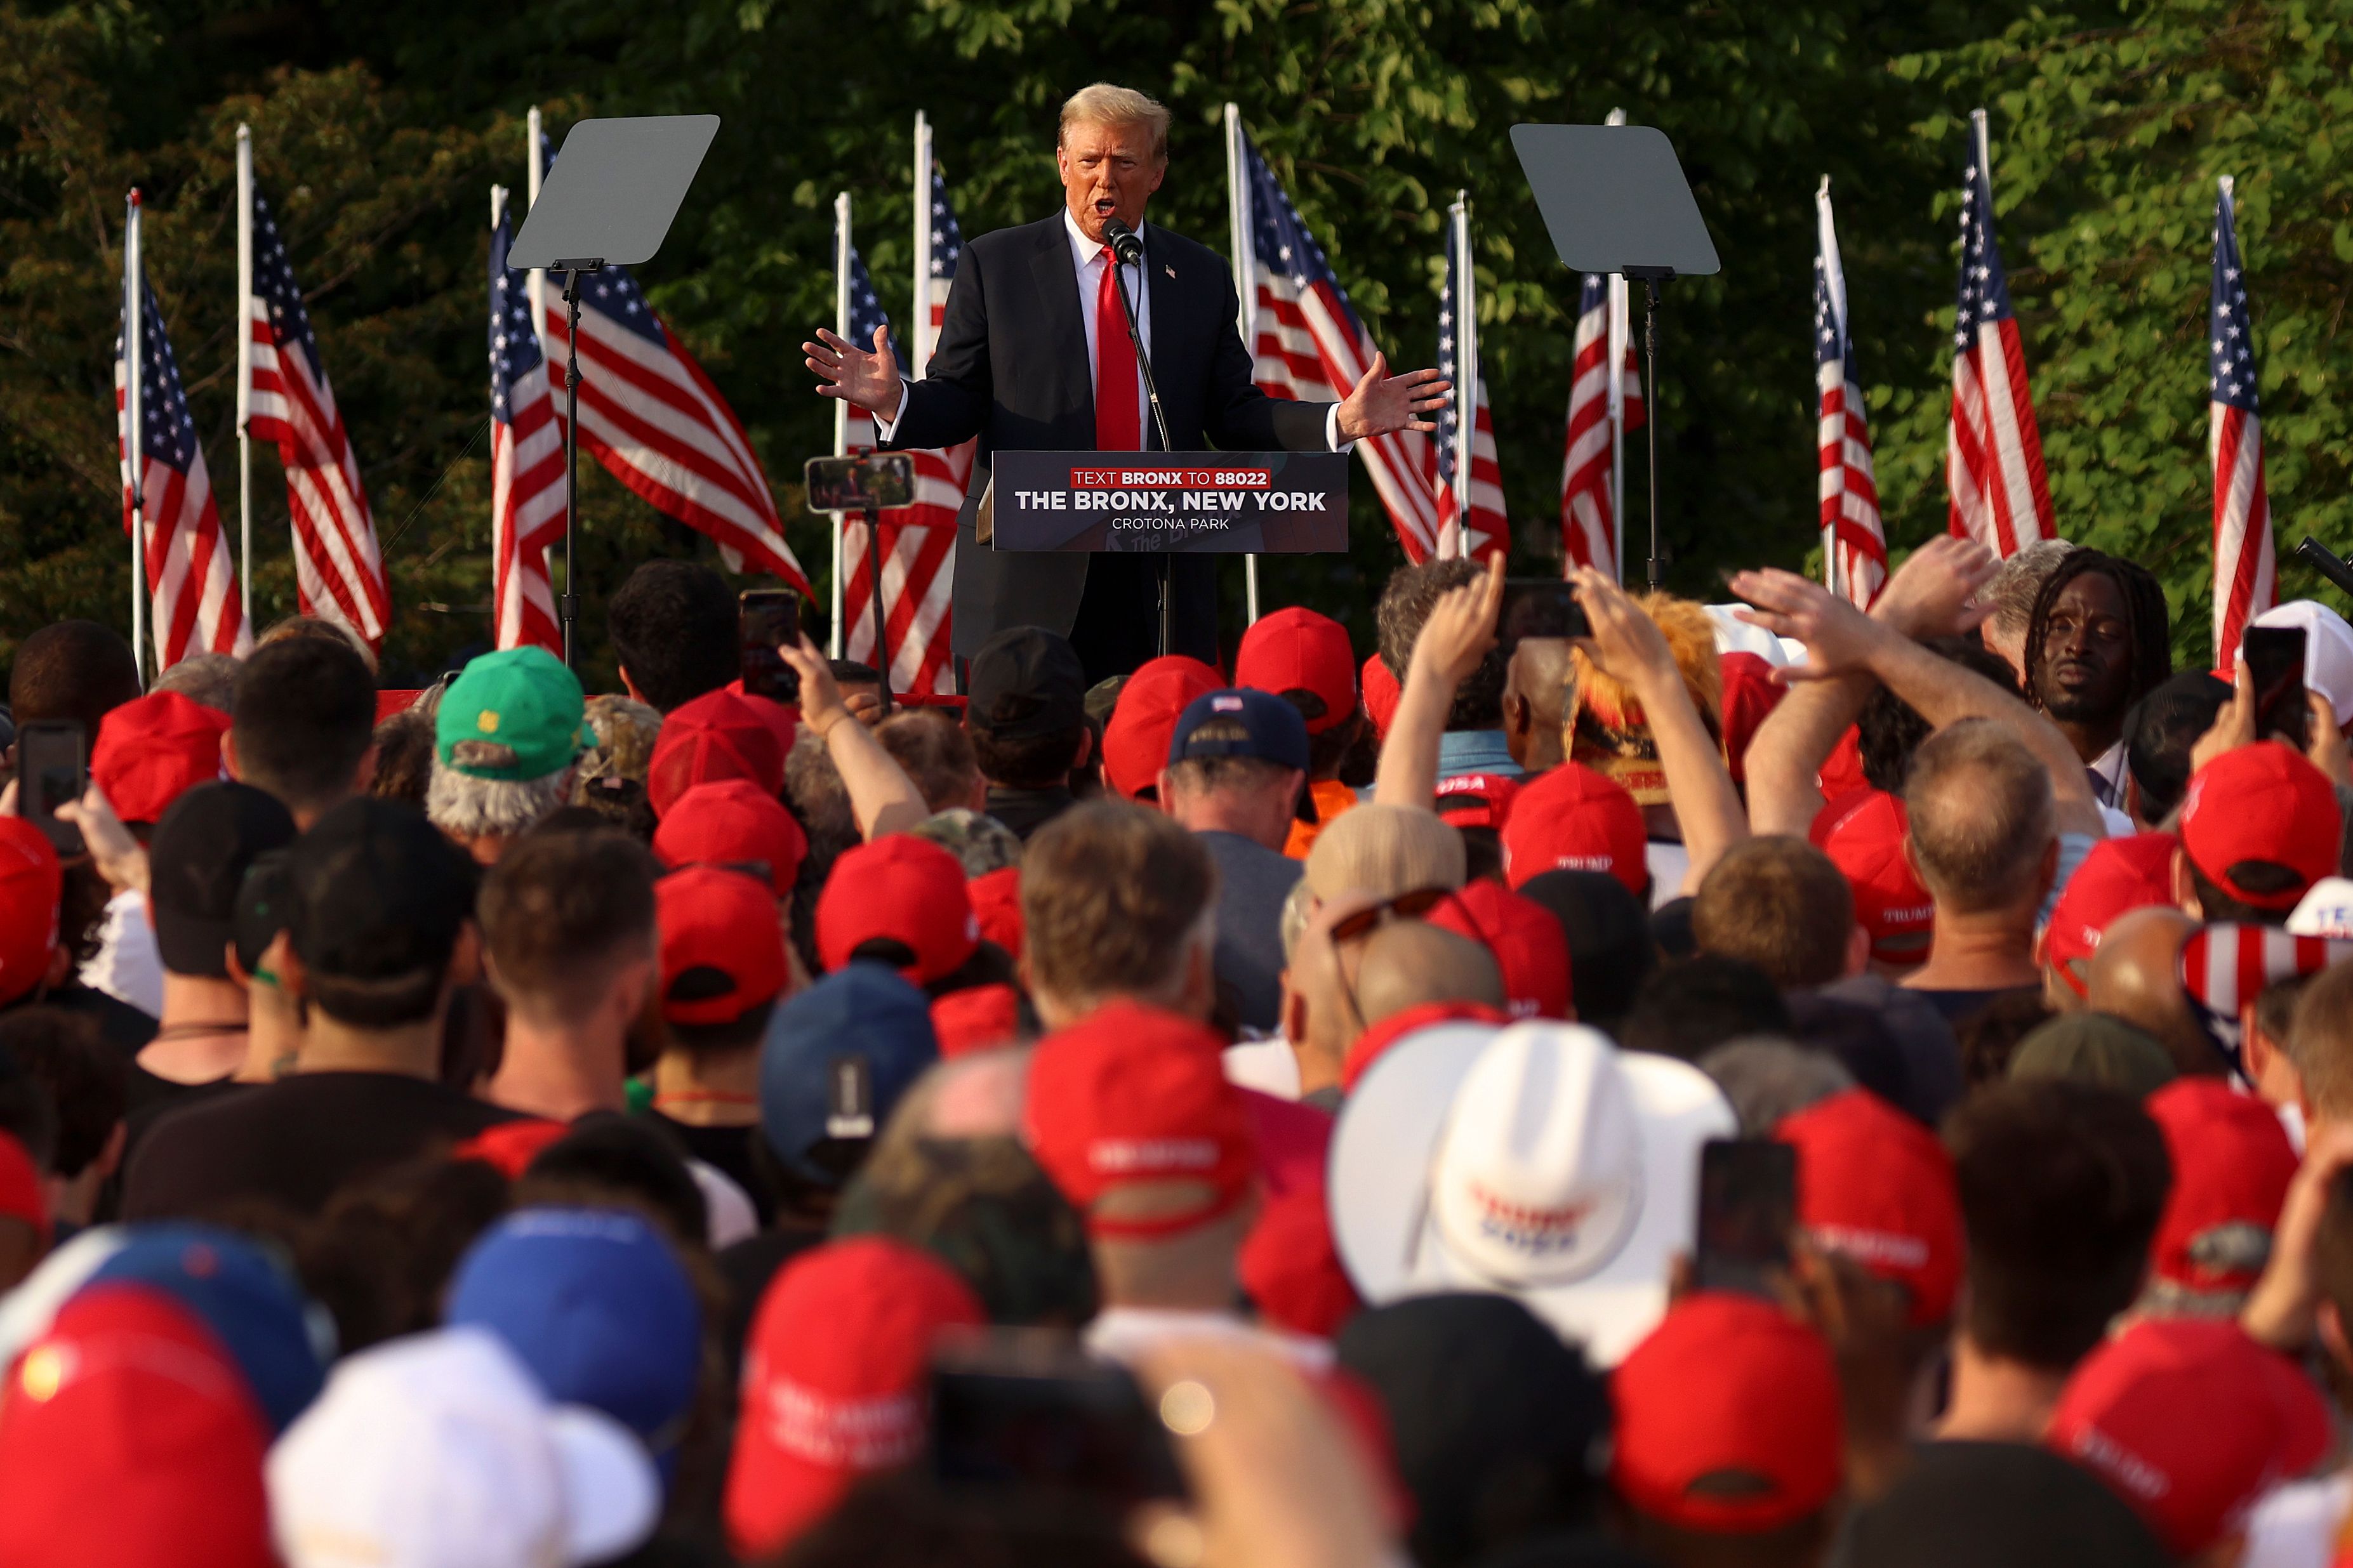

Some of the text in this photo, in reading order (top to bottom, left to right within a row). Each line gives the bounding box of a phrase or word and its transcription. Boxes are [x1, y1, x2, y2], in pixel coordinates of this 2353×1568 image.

[1074, 471, 1267, 485] TEXT BRONX TO 88022
[1015, 491, 1327, 513] THE BRONX, NEW YORK
[1112, 517, 1230, 530] CROTONA PARK
[1436, 775, 1485, 794] USA
